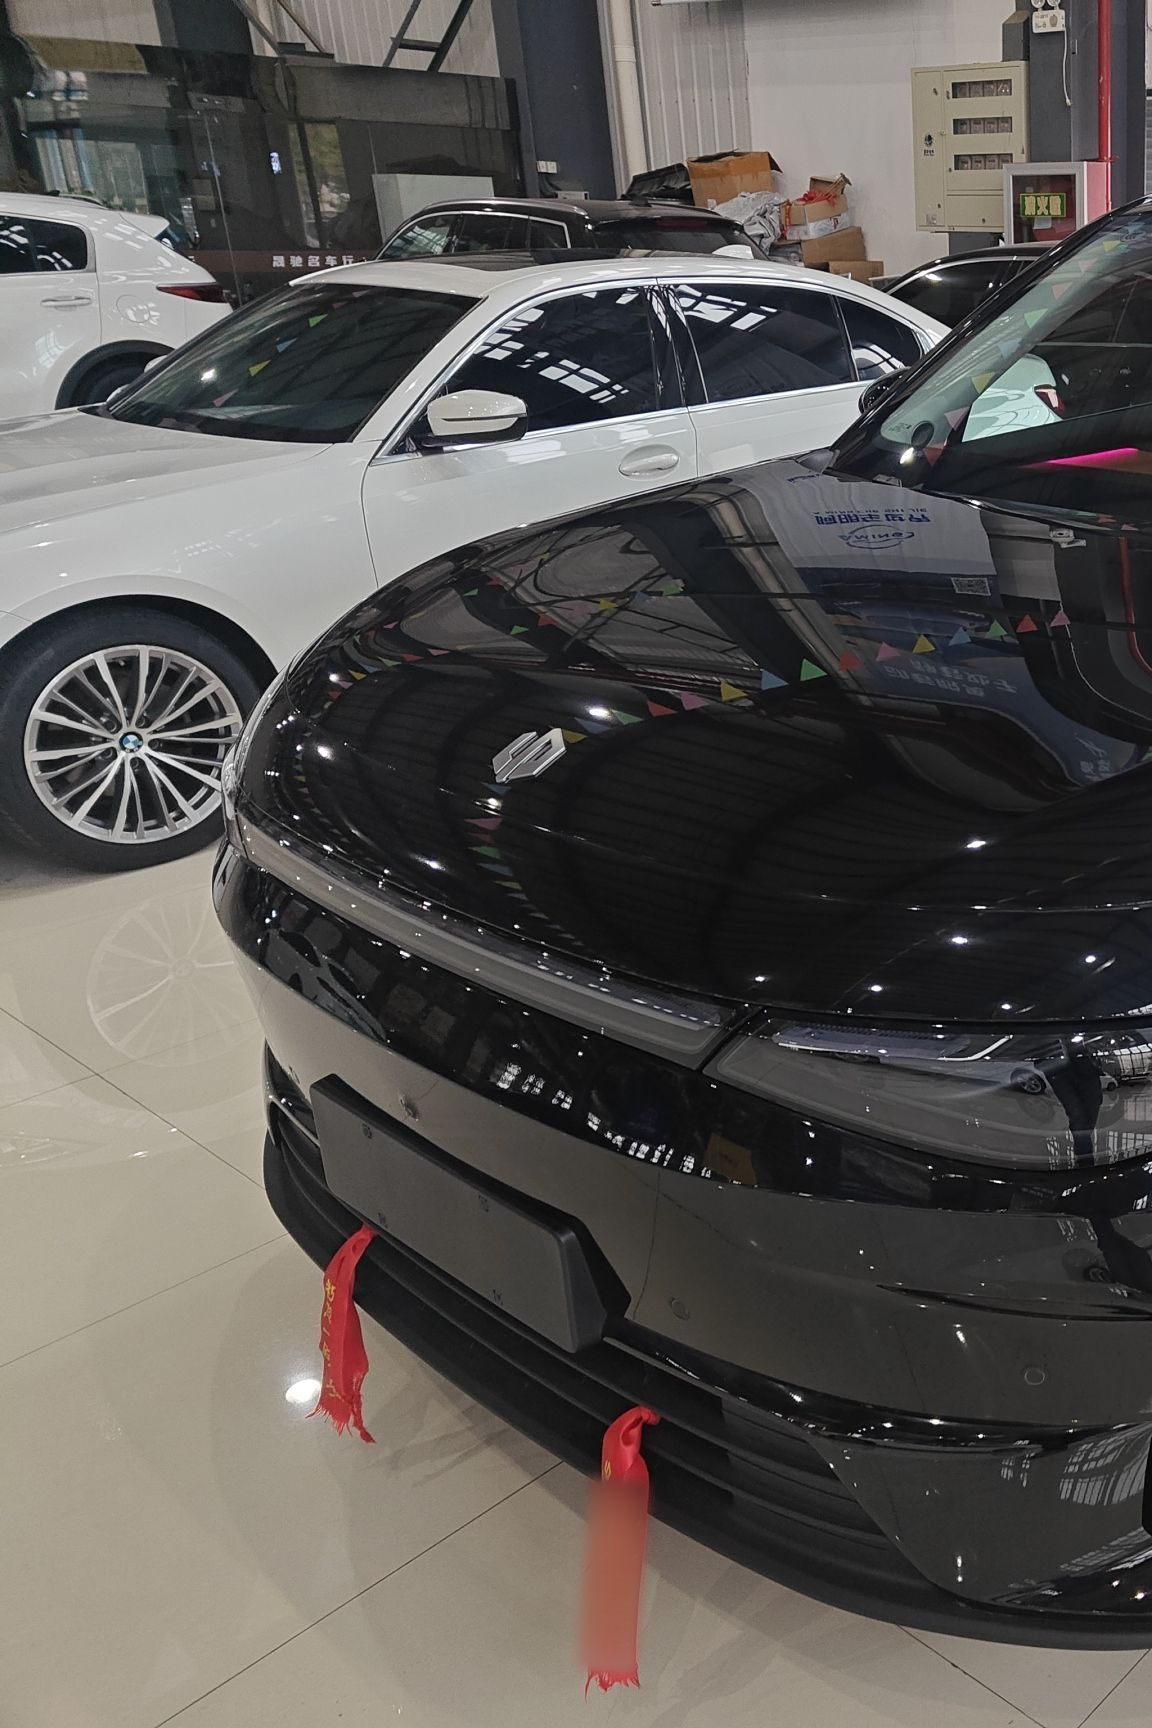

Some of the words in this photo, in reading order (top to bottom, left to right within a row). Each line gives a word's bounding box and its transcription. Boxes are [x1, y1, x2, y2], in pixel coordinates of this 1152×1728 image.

[272, 255, 355, 268] 晟驰名车行
